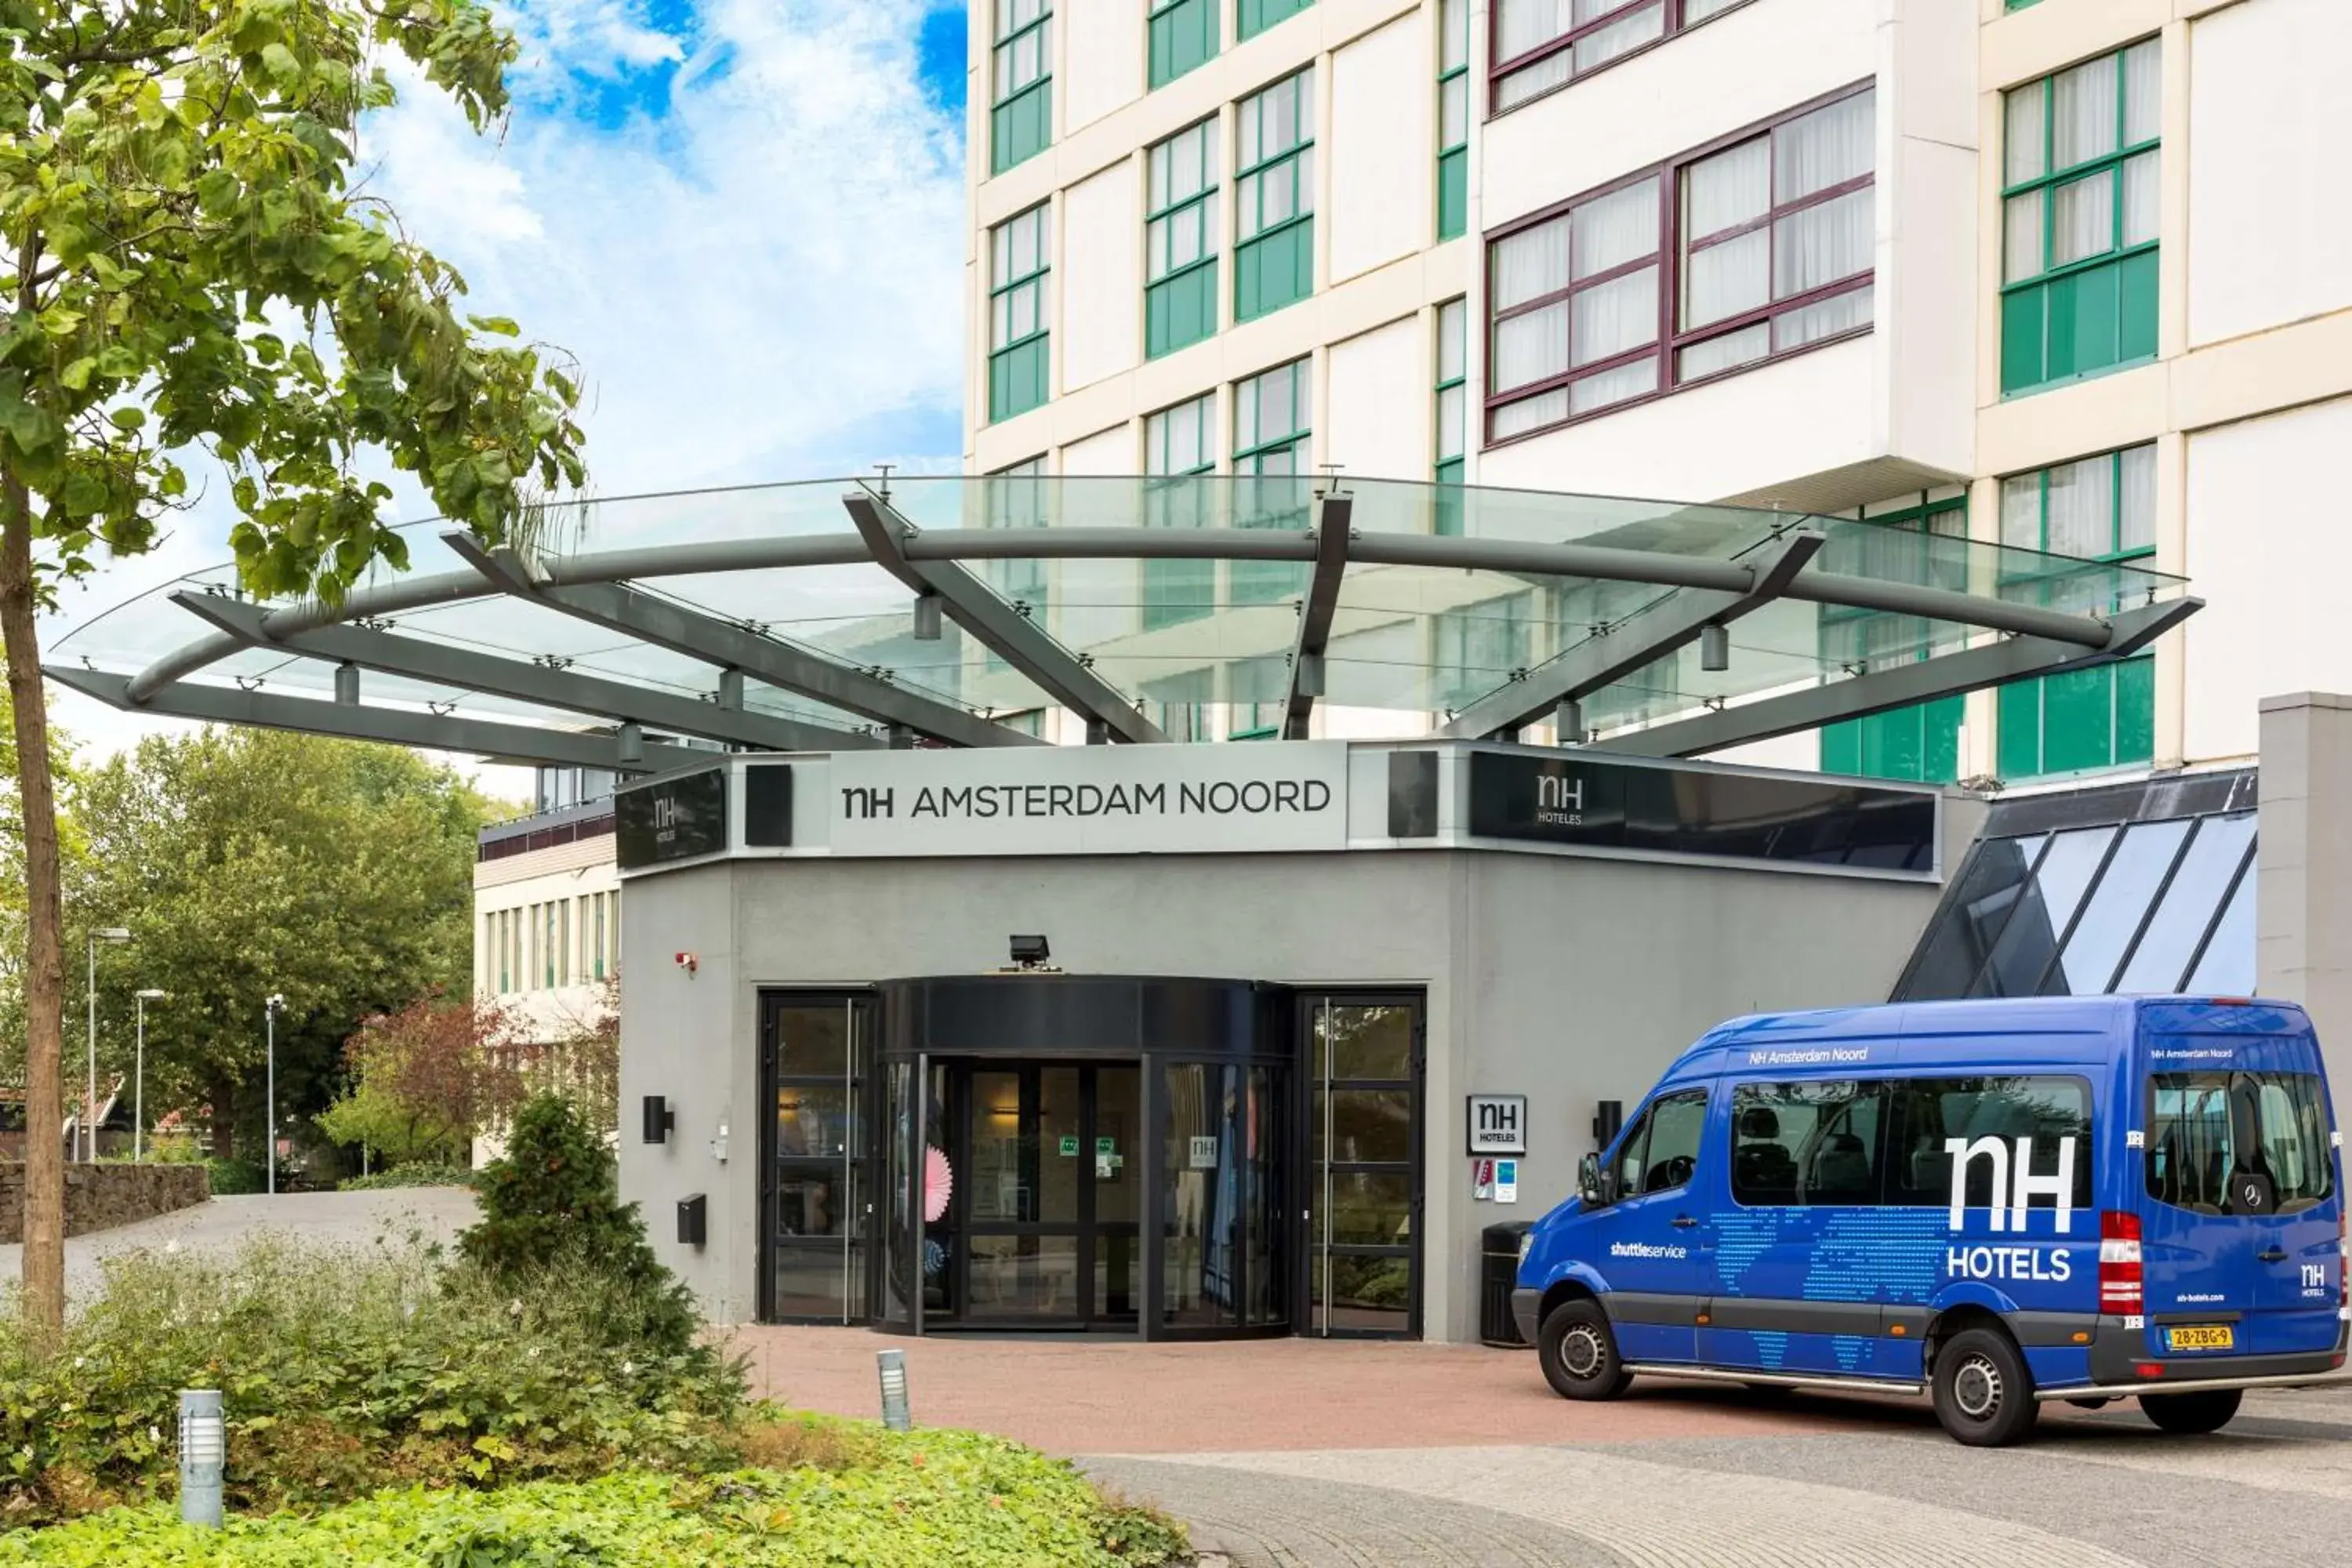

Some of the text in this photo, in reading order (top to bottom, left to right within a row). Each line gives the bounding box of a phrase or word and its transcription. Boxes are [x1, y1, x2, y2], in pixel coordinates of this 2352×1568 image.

[910, 782, 1166, 818] AMSTERDAM
[1180, 780, 1331, 814] NOORD
[1537, 811, 1581, 826] HOTELES
[1749, 1046, 1869, 1065] NH Amsterdam Noord
[1479, 1133, 1515, 1142] HOTELES
[1610, 1241, 1687, 1258] shuttleservice
[1947, 1246, 2071, 1282] HOTELS
[2174, 1329, 2228, 1345] 28-ZBG-9
